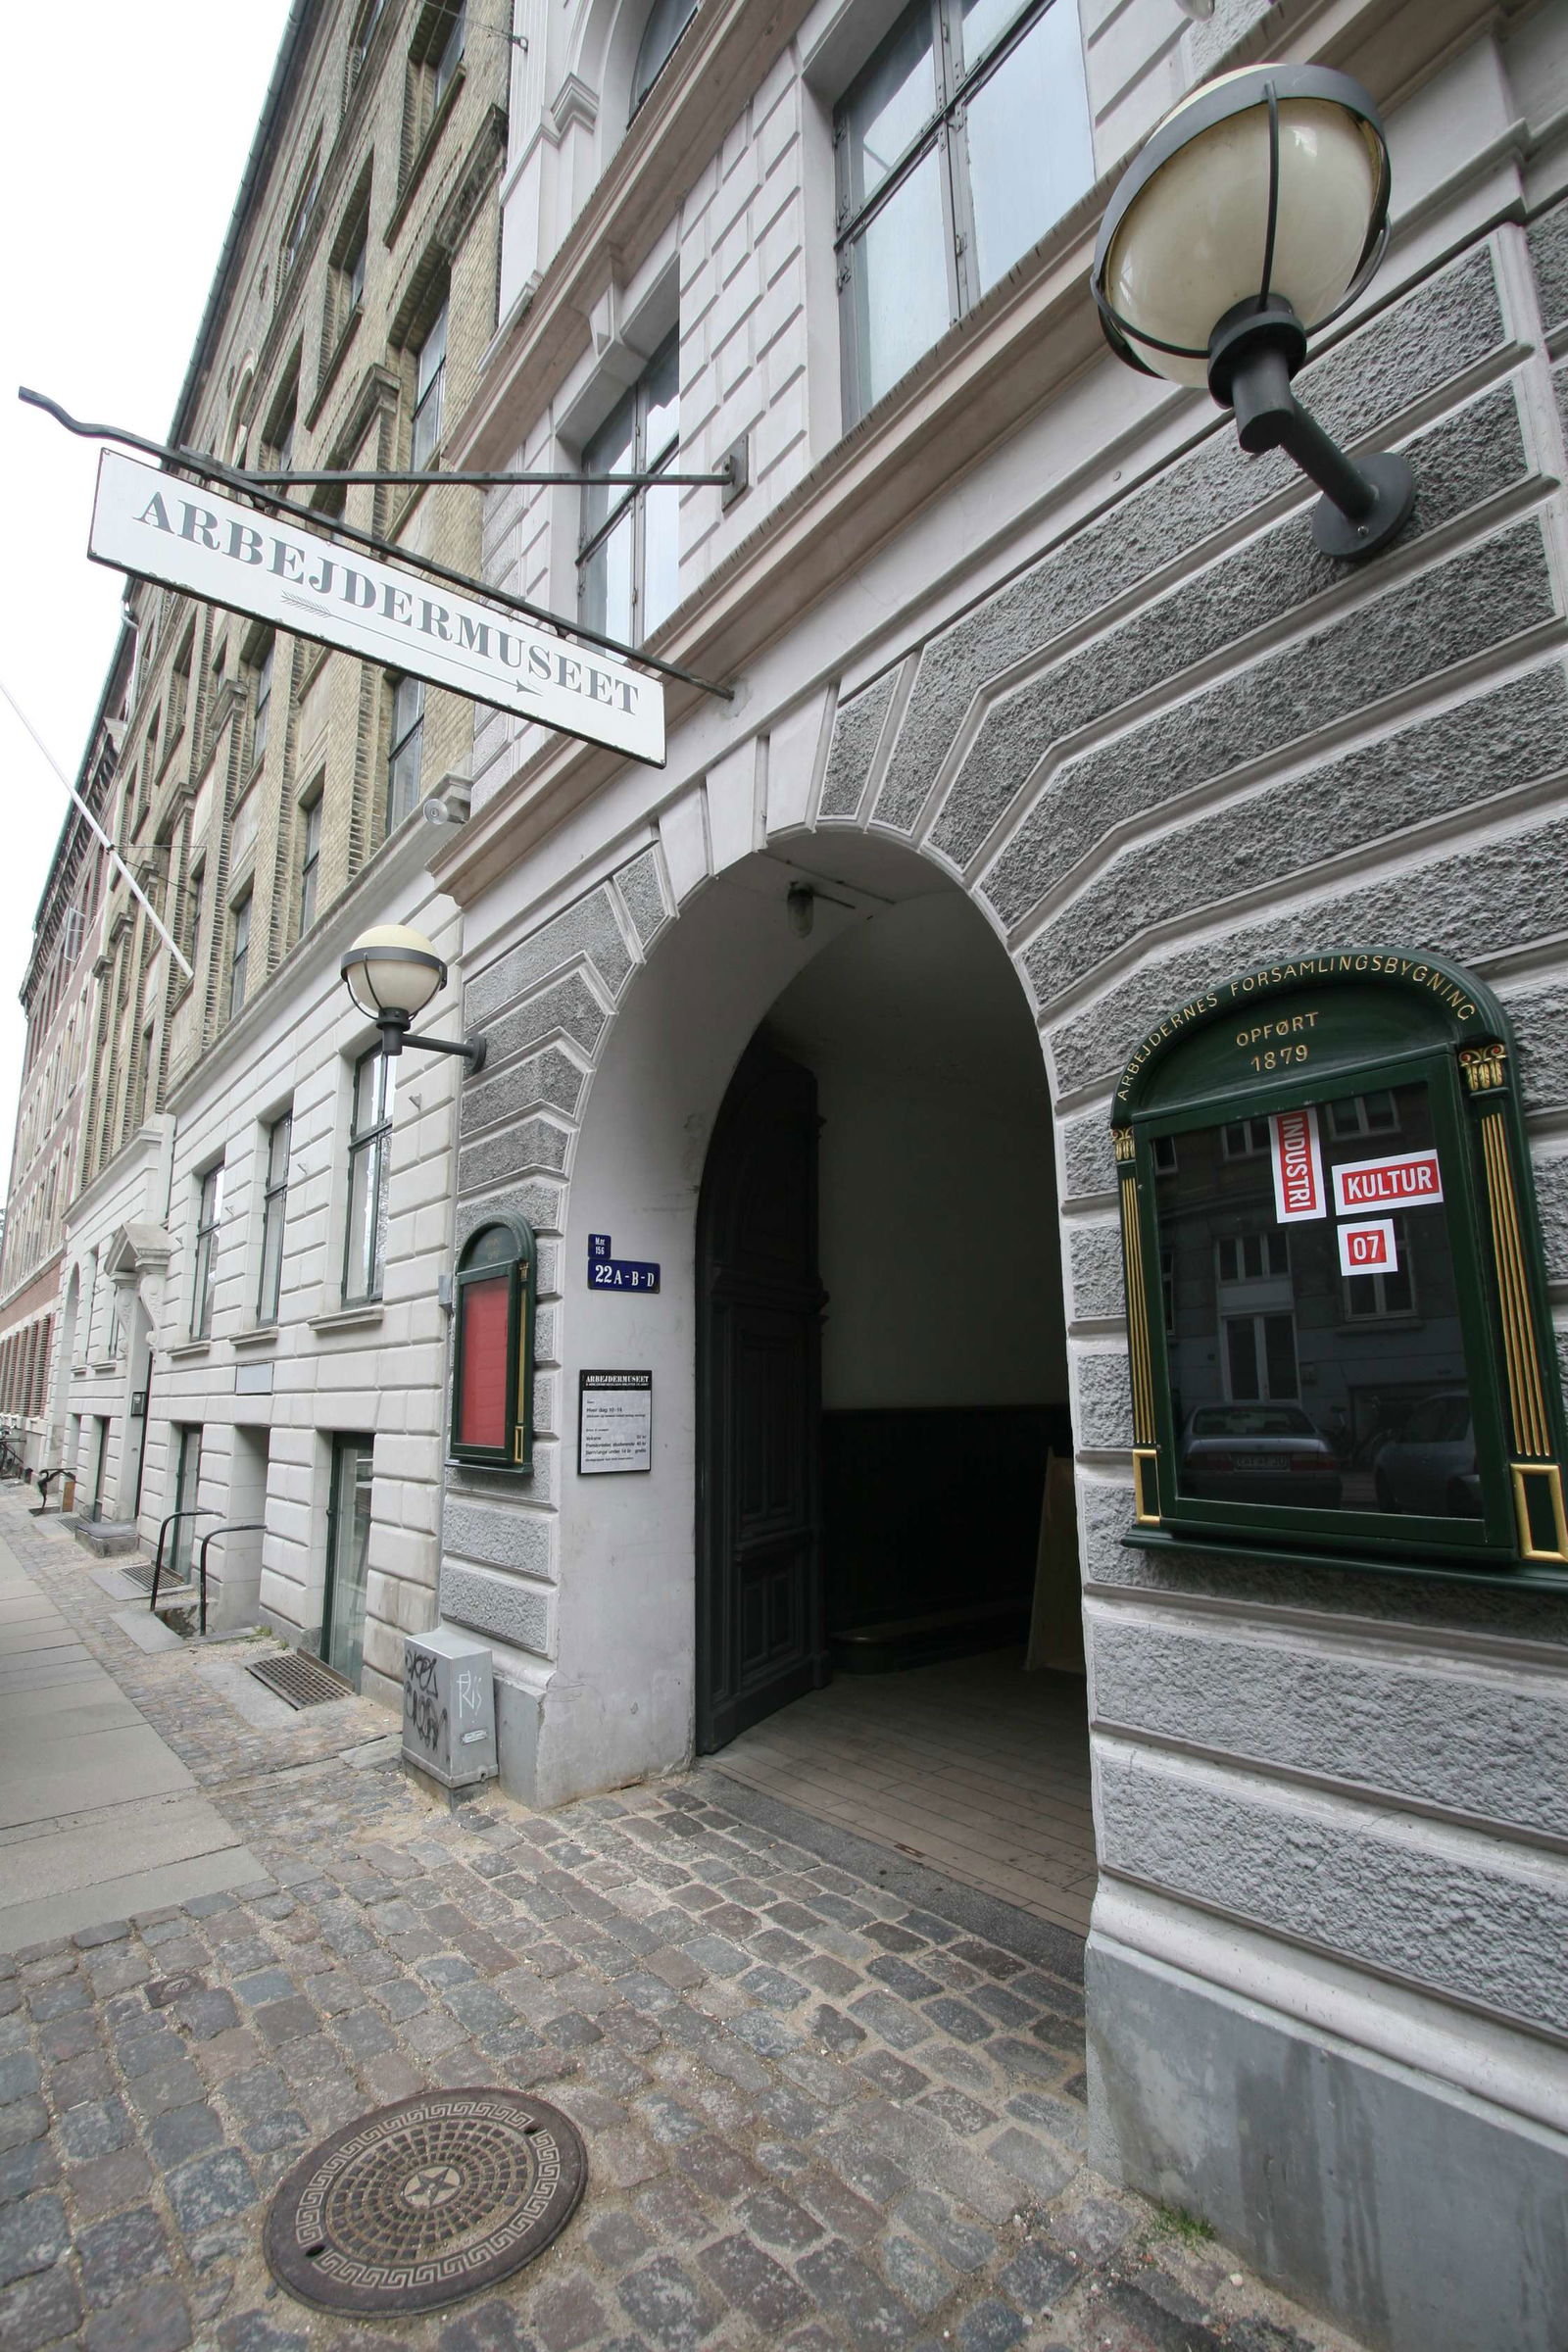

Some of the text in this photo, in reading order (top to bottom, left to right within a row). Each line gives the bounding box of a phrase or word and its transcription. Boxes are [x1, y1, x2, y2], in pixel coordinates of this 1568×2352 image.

[132, 490, 640, 716] ARBEJDERMUSEET
[1117, 954, 1475, 1102] ARBEJDERNES FORSAMLINGSBYGNING
[1236, 1011, 1320, 1047] OPFØRT
[1250, 1044, 1309, 1073] 1879
[1282, 1117, 1311, 1208] INDUSTRI
[1348, 1166, 1433, 1200] KULTUR
[1353, 1235, 1379, 1261] 07
